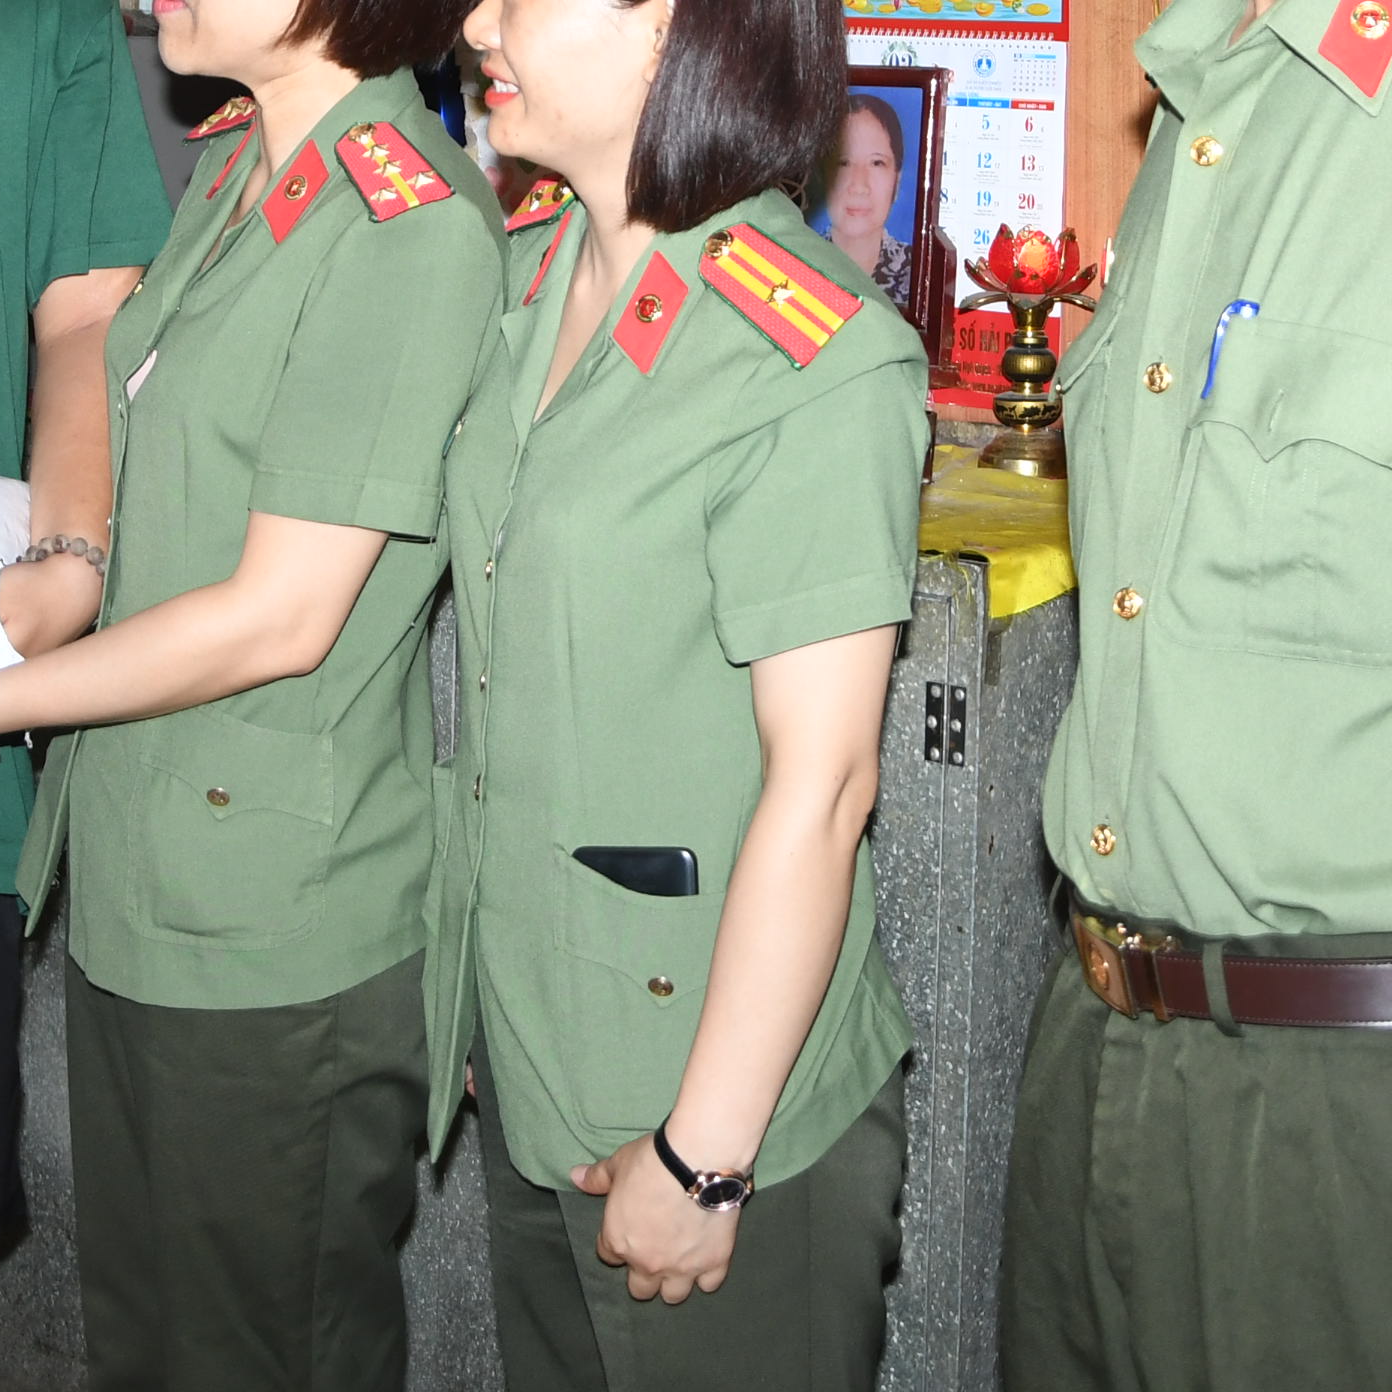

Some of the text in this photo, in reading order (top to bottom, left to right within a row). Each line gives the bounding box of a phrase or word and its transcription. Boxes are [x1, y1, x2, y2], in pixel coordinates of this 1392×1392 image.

[981, 114, 991, 131] 5
[1025, 115, 1034, 133] 6
[977, 152, 993, 169] 12
[1021, 154, 1036, 172] 13
[976, 189, 992, 208] 19
[1018, 192, 1035, 210] 20
[973, 227, 990, 245] 26
